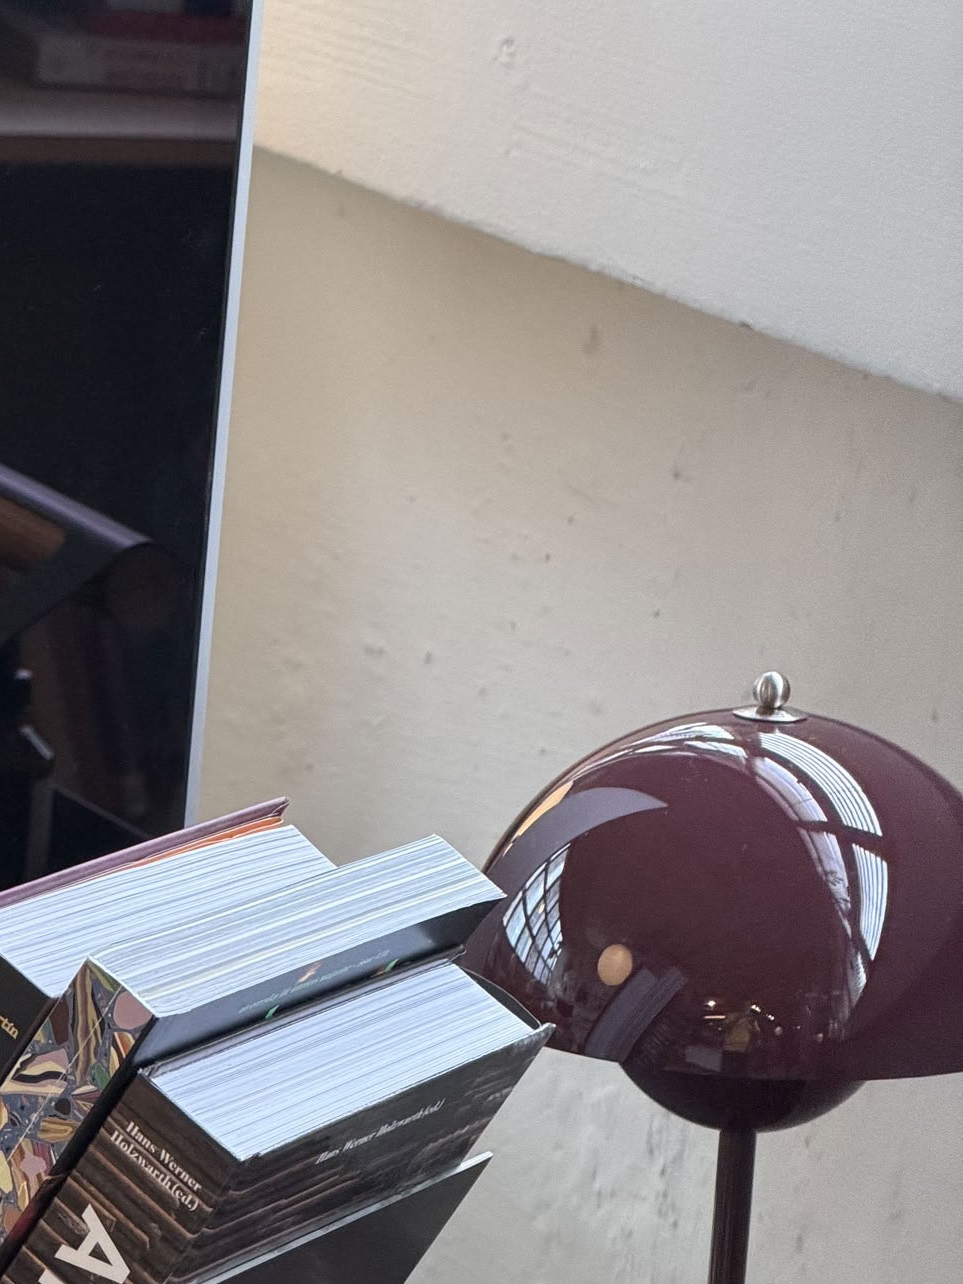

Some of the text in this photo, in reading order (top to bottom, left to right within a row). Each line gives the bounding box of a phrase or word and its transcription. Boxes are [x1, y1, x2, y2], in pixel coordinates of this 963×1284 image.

[110, 1130, 200, 1212] Holzwarth (ed.)
[125, 1121, 202, 1191] Hans Werner
